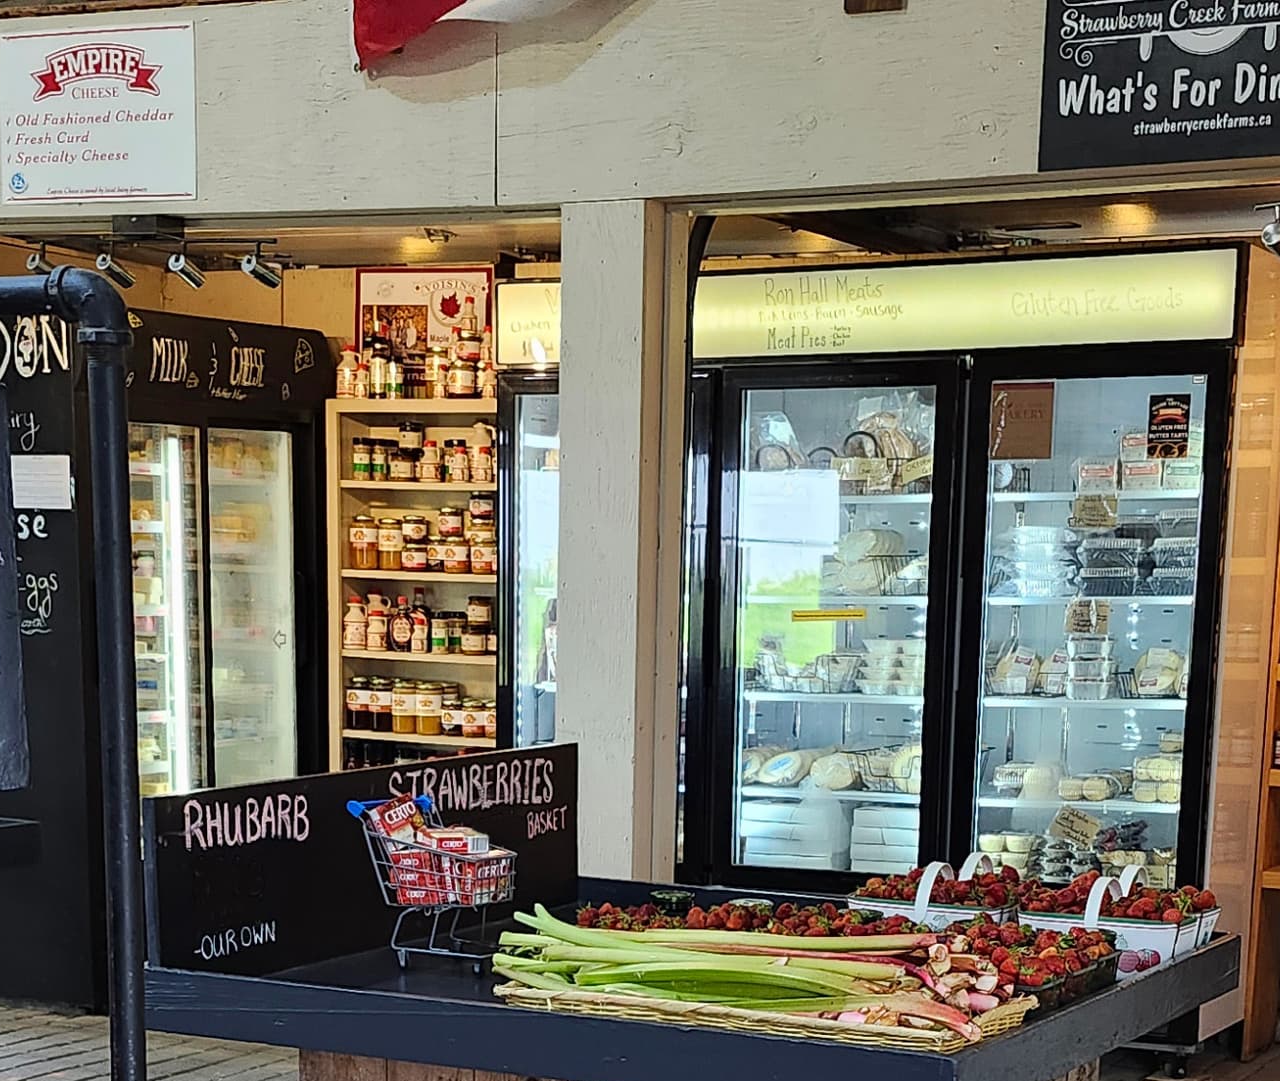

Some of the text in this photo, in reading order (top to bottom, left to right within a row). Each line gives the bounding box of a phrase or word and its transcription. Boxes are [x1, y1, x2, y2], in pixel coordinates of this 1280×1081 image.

[1061, 8, 1163, 39] Strawberry
[1169, 0, 1226, 27] Creek
[1230, 0, 1280, 25] Farm
[50, 48, 139, 82] EMPIRE
[71, 86, 119, 100] CHEESE
[1058, 70, 1158, 117] What's
[1172, 68, 1221, 109] For
[15, 108, 174, 127] Old Fashioned Cheddar
[1133, 112, 1272, 136] strawberrycreekfarms.ca
[15, 130, 90, 145] Fresh Curd
[15, 149, 129, 166] Specialty Cheese
[765, 275, 884, 306] Ron Hall Meats
[1011, 286, 1184, 317] Gluten Free Goods
[767, 325, 826, 350] Meat Pies
[149, 337, 188, 382] MILK
[229, 346, 266, 387] CHEESE
[389, 758, 554, 811] STRAWBERRIES
[183, 793, 311, 851] RHUBARB
[384, 801, 417, 825] CERTO
[527, 806, 568, 840] BASKET
[241, 921, 277, 947] OWN
